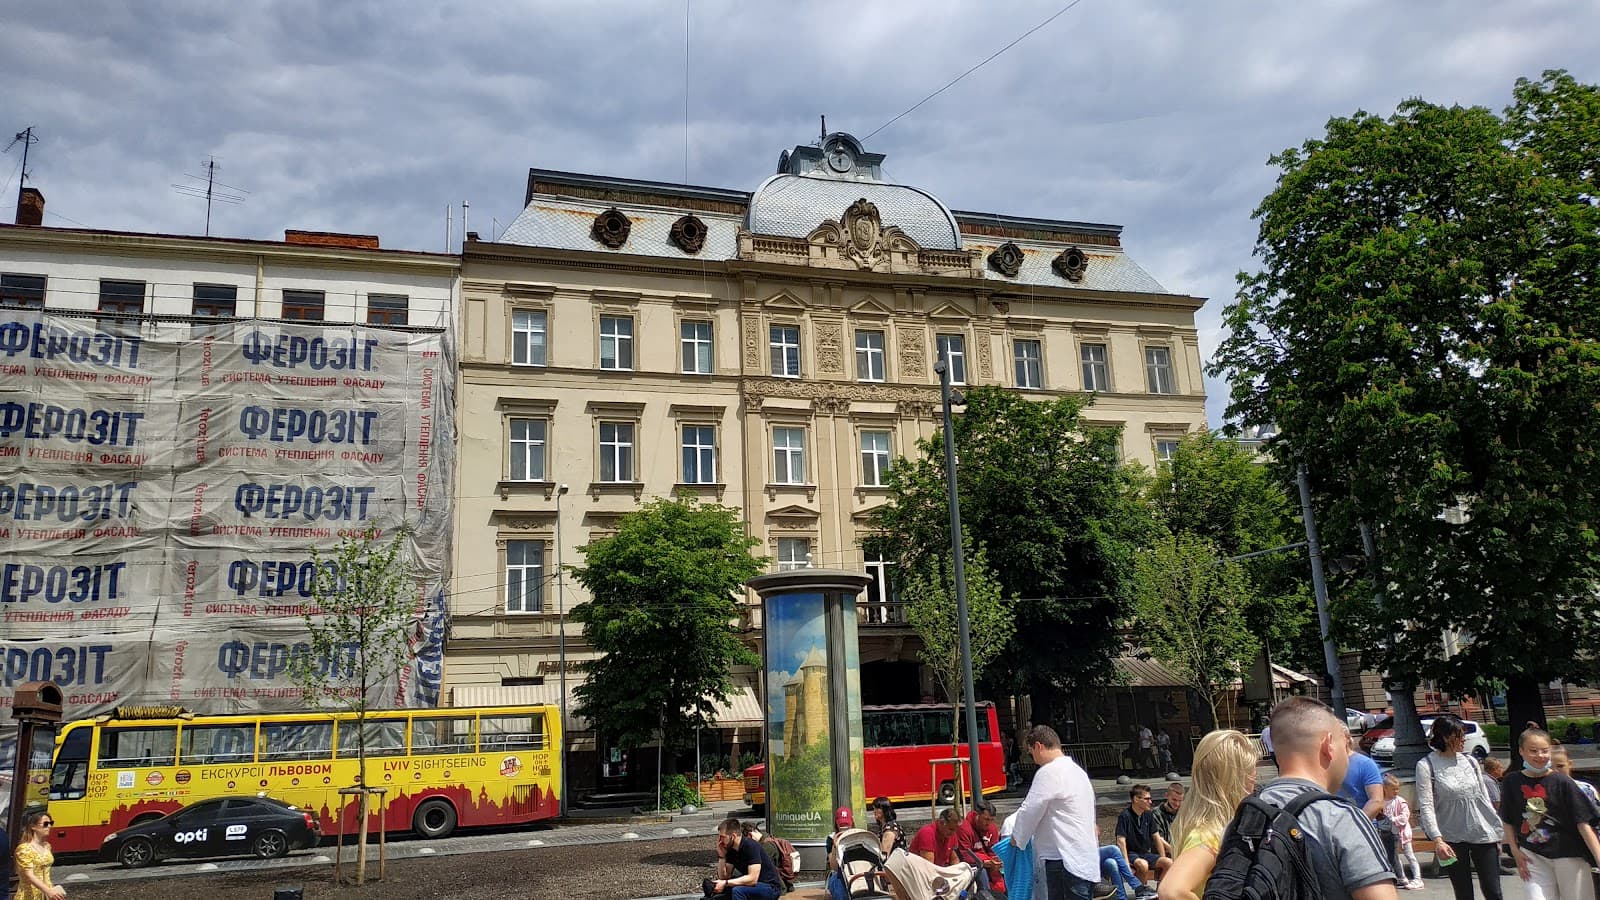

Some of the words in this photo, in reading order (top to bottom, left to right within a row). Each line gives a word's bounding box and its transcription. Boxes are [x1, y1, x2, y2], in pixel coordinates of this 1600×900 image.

[0, 321, 142, 369] ФЕРОЗІТ
[242, 330, 378, 372] ФЕРОЗІТ
[34, 366, 98, 383] УТЕПЛЕННЯ
[104, 374, 152, 386] ФАСАДУ
[222, 371, 271, 383] СИСТЕМА
[277, 375, 337, 386] УТЕПЛЕННЯ
[343, 378, 385, 389] ФАСАДУ
[421, 368, 432, 410] СИСТЕМА
[239, 405, 378, 446] ФЕРОЗІТ
[418, 415, 431, 468] УТЕПЛЕННЯ
[28, 447, 94, 463] УТЕПЛЕННЯ
[101, 452, 149, 466] ФАСАДУ
[219, 447, 268, 458] СИСТЕМА
[274, 449, 335, 460] УТЕПЛЕННЯ
[341, 451, 384, 464] ФАСАДУ
[235, 482, 375, 520] ФЕРОЗІТ
[17, 528, 86, 540] УТЕПЛЕННЯ
[93, 526, 141, 538] ФАСАДУ
[213, 524, 262, 537] СИСТЕМА
[269, 527, 331, 538] УТЕПЛЕННЯ
[1, 562, 126, 603] ЕРОЗІТ
[183, 560, 199, 617] ferozit.ua
[4, 610, 74, 623] УТЕПЛЕННЯ
[81, 606, 131, 620] ФАСАДУ
[205, 603, 257, 614] СИСТЕМА
[170, 640, 189, 700] ferozit.ua
[69, 691, 120, 704] ФАСАДУ
[194, 687, 247, 698] СИСТЕМА
[268, 764, 332, 776] ЛЬВОВОМ
[384, 760, 410, 772] LVIV
[413, 757, 487, 769] SIGHTSEEING
[174, 828, 208, 844] opti
